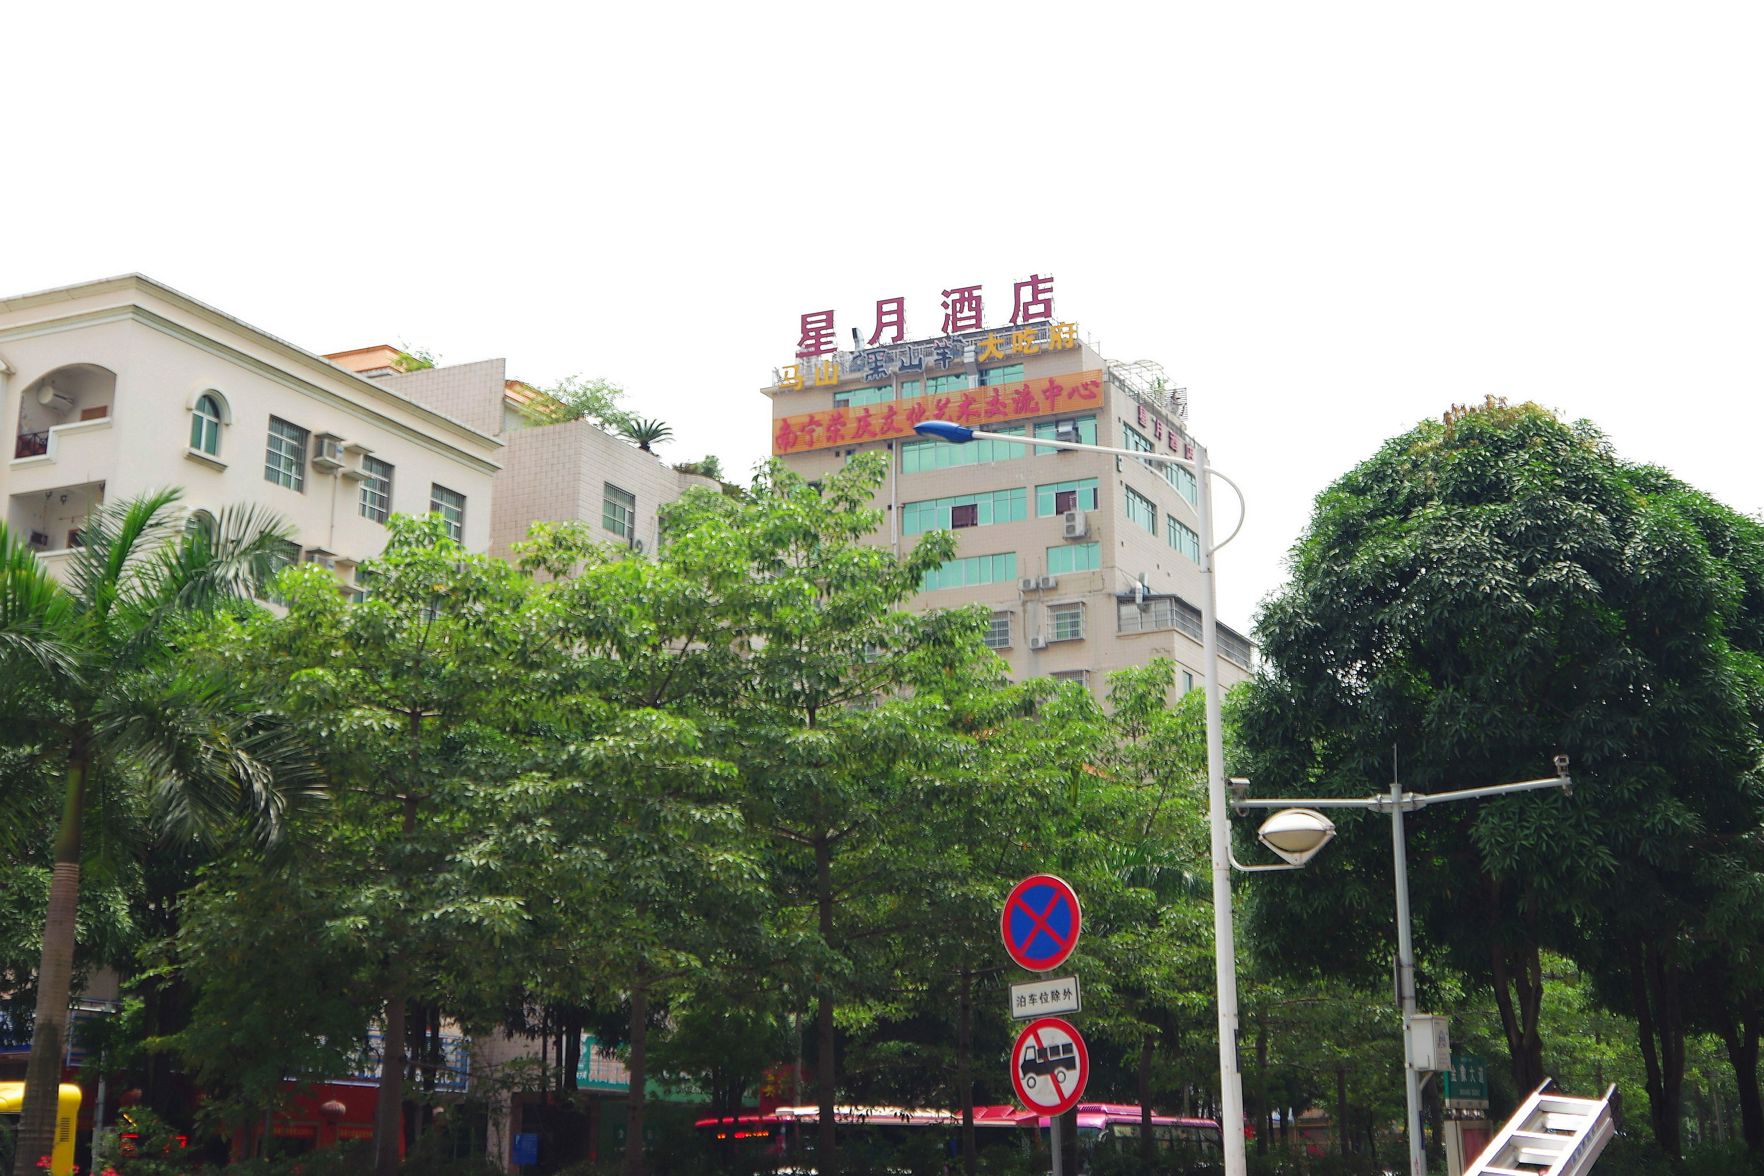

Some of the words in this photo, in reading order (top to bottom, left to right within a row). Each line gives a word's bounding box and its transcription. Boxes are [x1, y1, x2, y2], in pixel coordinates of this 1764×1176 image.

[796, 274, 1054, 358] 星月酒店
[1016, 988, 1072, 1008] 泊车位除外
